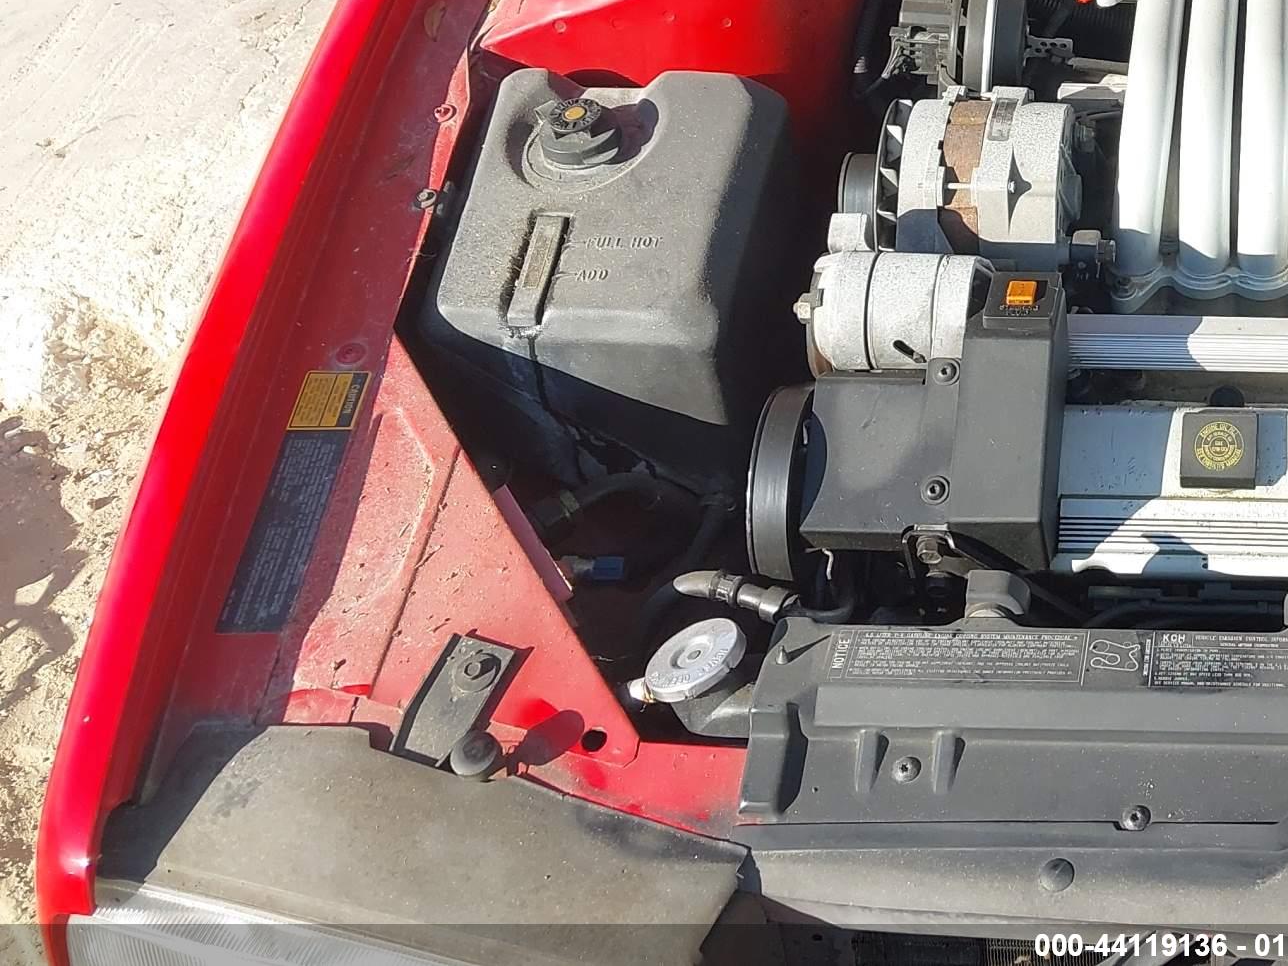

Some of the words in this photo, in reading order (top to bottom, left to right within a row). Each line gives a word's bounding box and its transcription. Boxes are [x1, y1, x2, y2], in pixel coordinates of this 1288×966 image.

[585, 237, 624, 249] FULL
[631, 237, 663, 248] HOT
[576, 269, 609, 281] ADD
[832, 638, 850, 669] NOTICE
